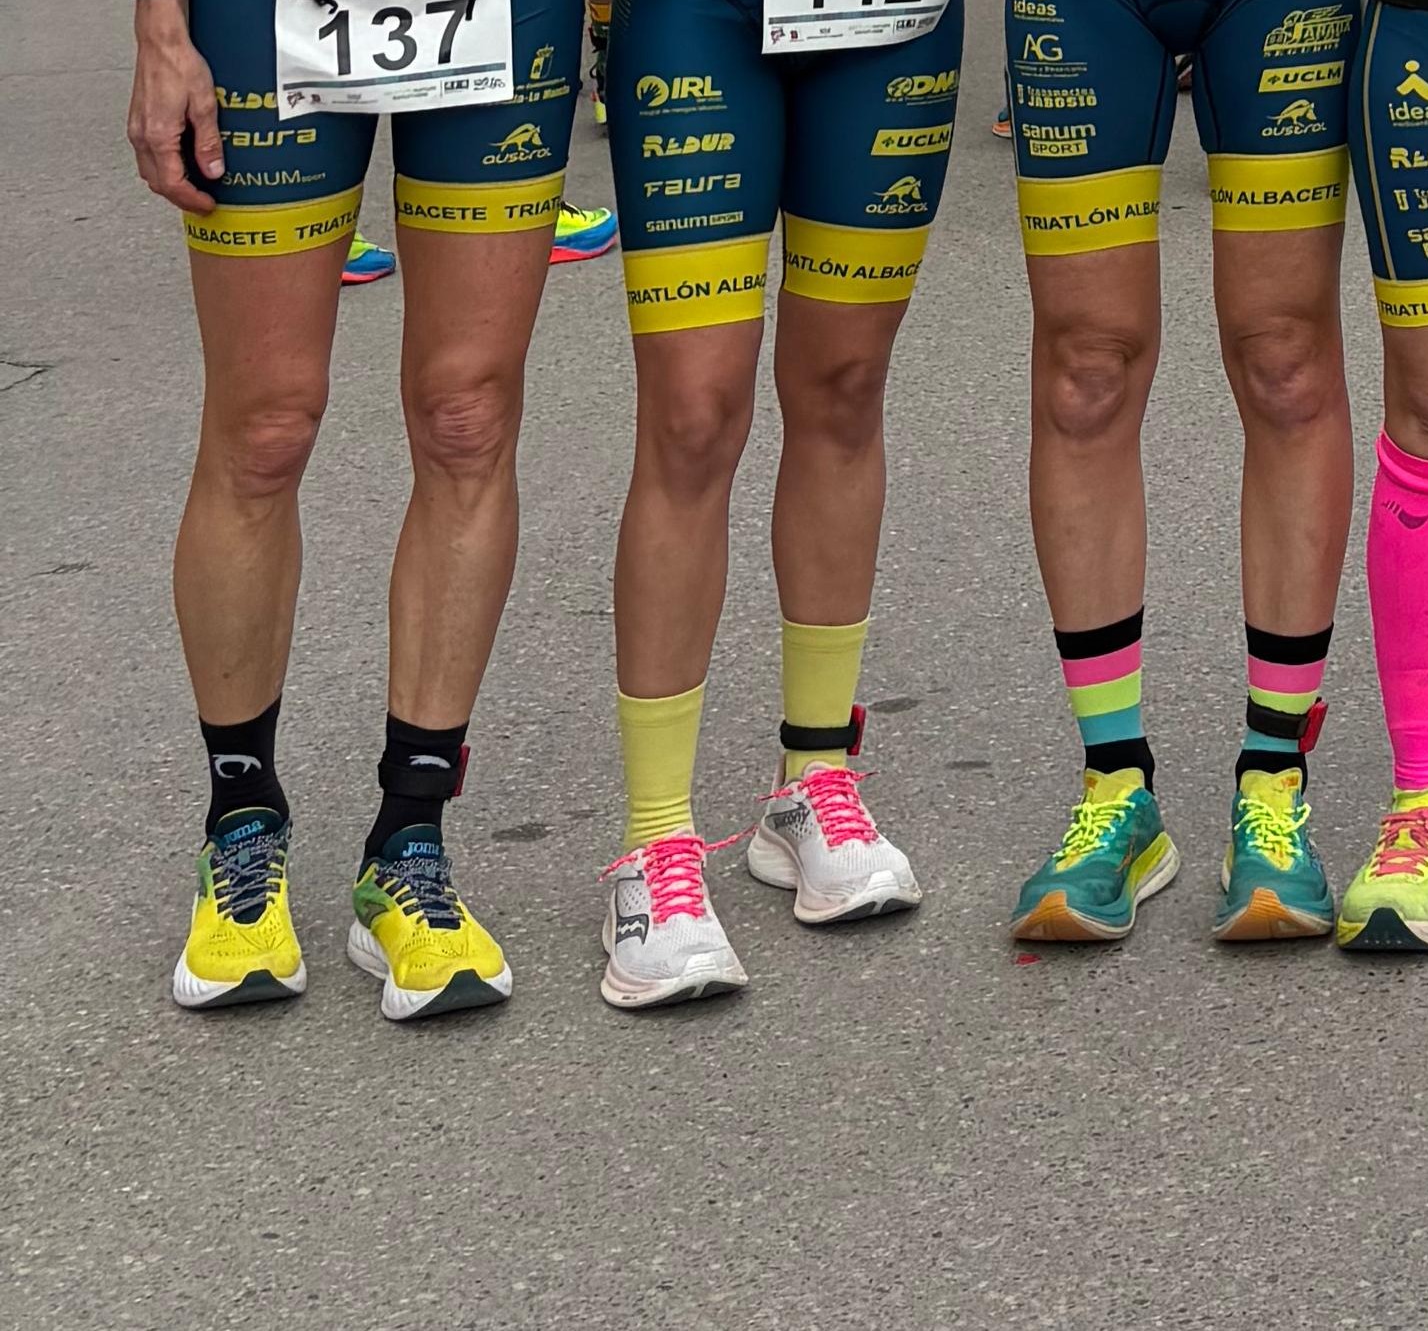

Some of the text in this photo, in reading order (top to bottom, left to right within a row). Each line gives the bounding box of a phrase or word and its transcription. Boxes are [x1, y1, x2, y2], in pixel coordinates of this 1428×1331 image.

[1022, 33, 1063, 62] AG
[671, 75, 723, 99] IRL
[1282, 68, 1342, 85] UCLM
[897, 130, 950, 148] UCLM
[1022, 122, 1096, 140] sanum
[1237, 182, 1342, 206] ALBACETE
[646, 213, 708, 233] sanum
[1026, 206, 1120, 230] TRIATLÓN
